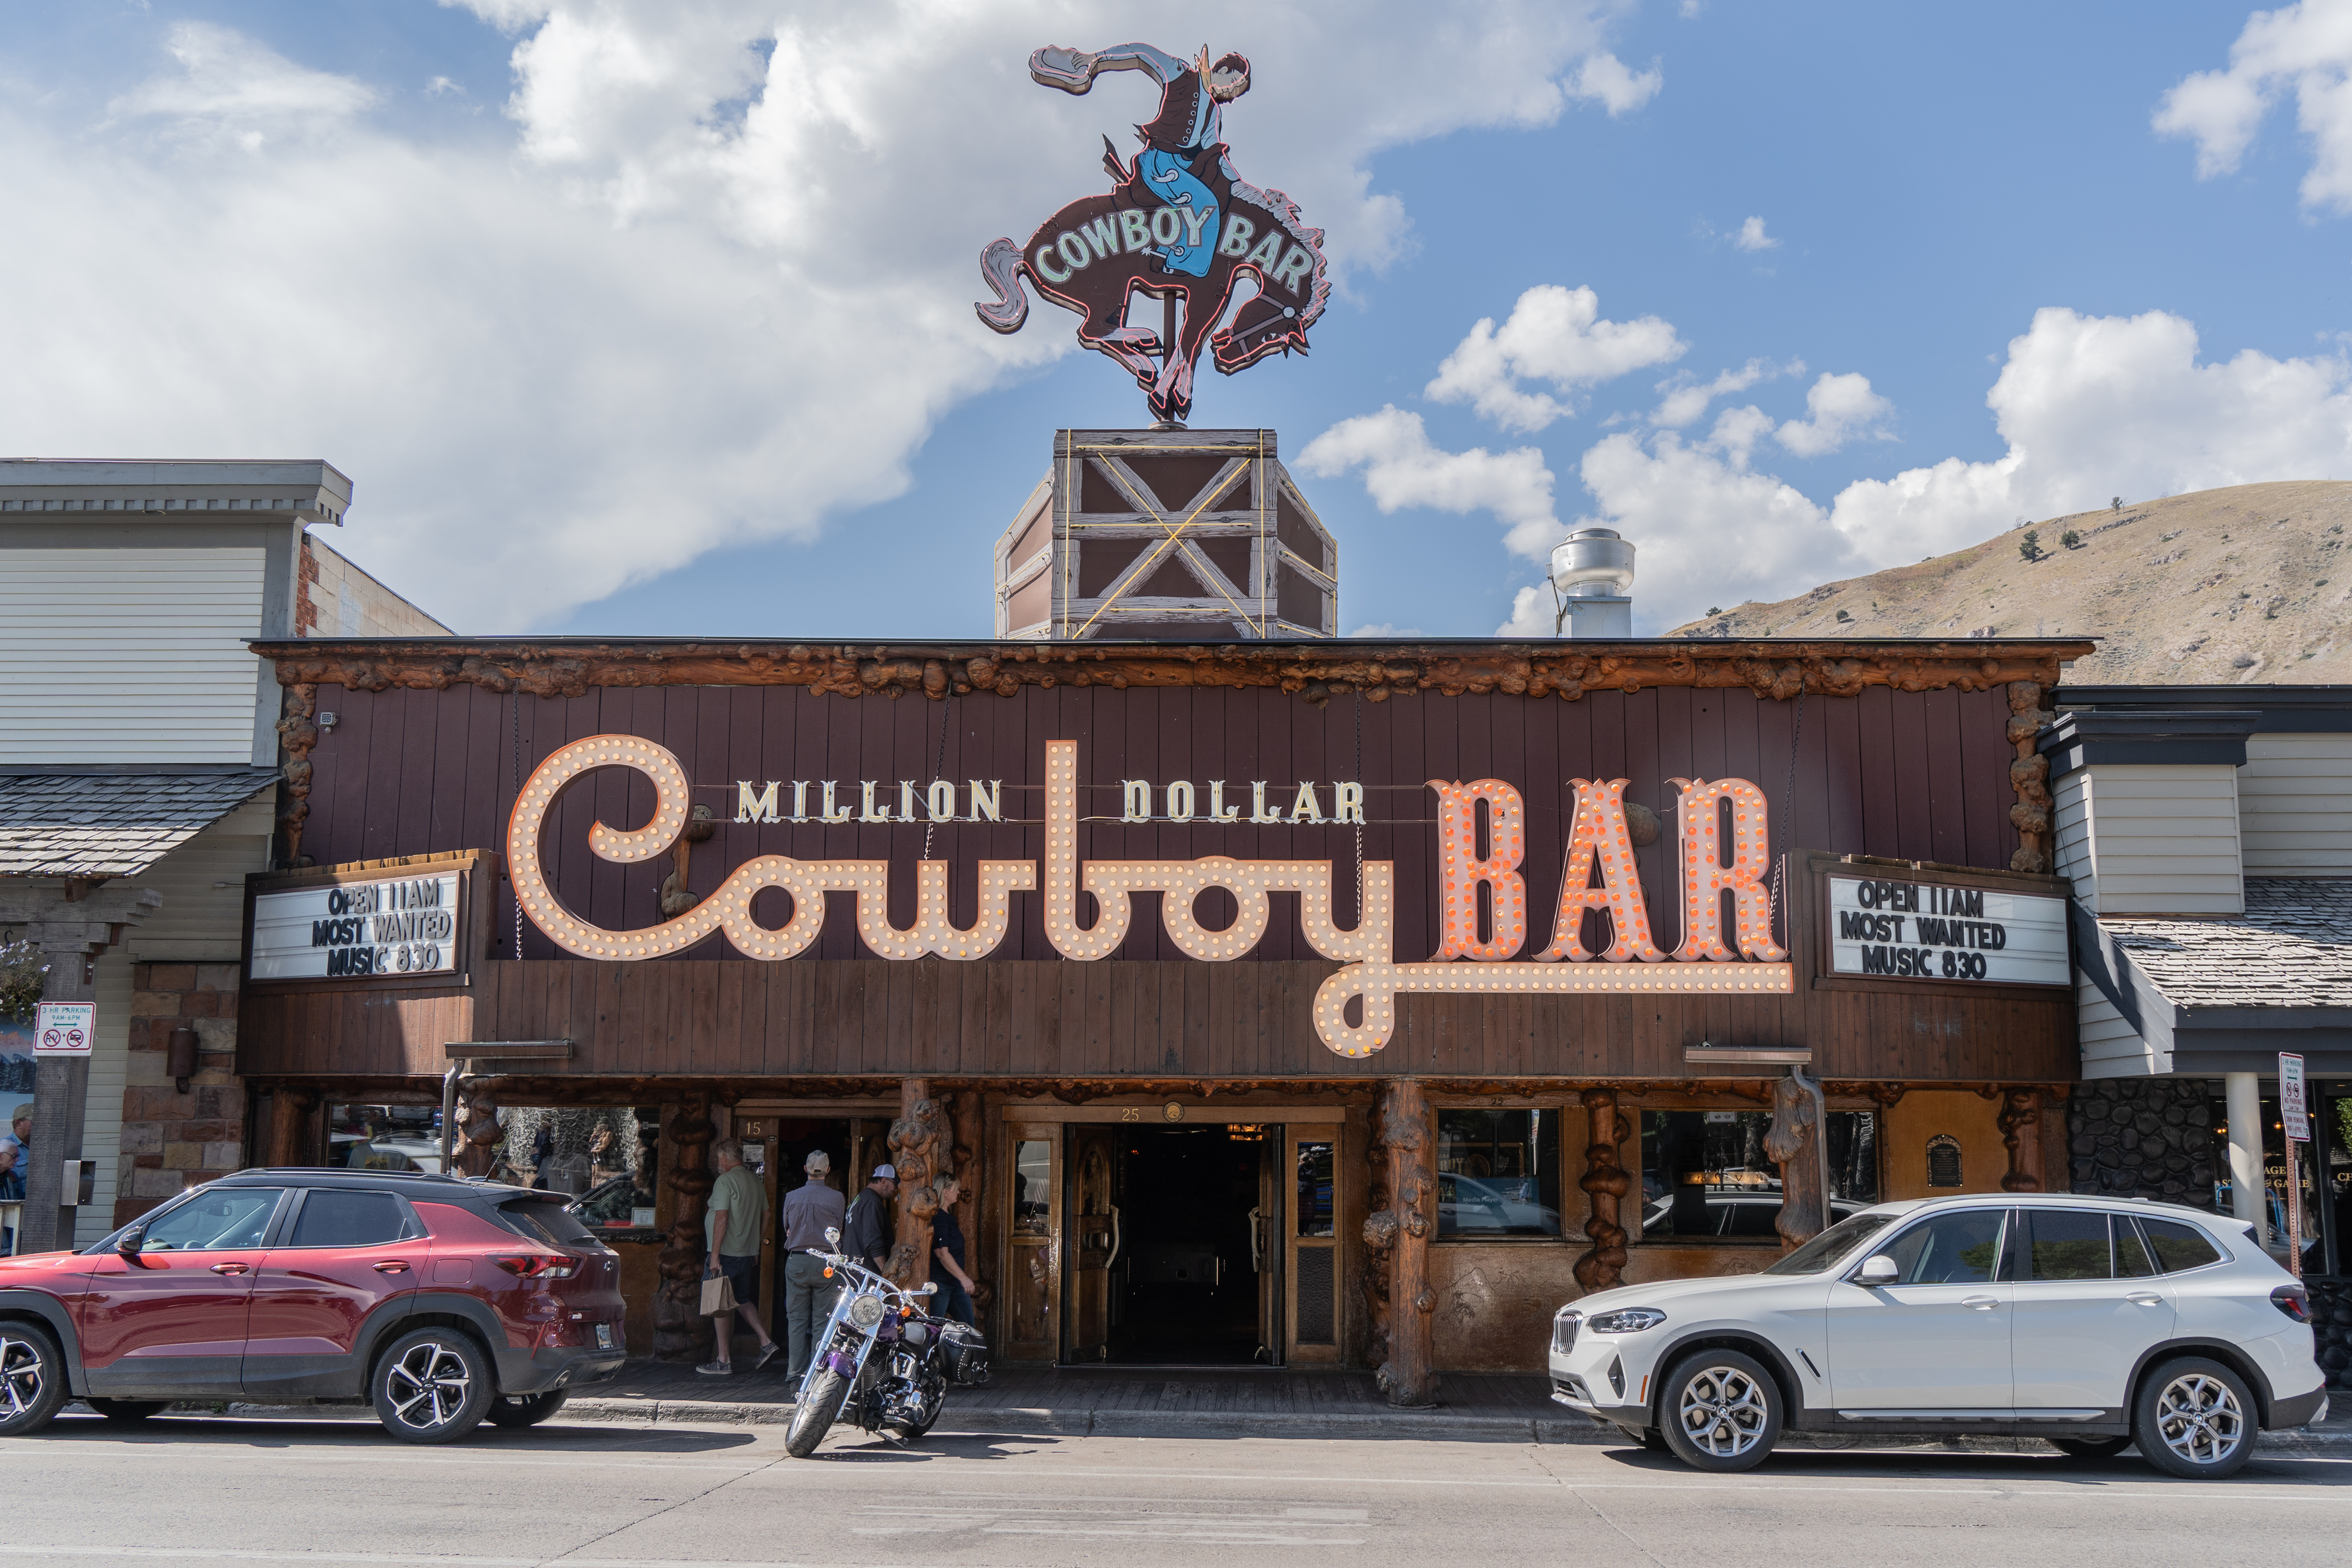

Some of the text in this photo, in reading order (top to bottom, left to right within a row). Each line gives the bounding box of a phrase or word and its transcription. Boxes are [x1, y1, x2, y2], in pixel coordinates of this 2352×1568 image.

[1035, 206, 1315, 297] COWBOY BAR
[734, 780, 1366, 824] MILLION DOLLAR
[328, 884, 378, 915] OPEN
[507, 734, 1790, 1058] Cowboy BAR
[1858, 881, 1919, 912] OPEN
[312, 910, 451, 947] MOST WANTED
[1840, 911, 2006, 951] MOST WANTED
[327, 942, 439, 976] MUSIC 830
[1862, 945, 1987, 979] MUSIC 830
[2290, 1059, 2301, 1067] PARKING
[746, 1121, 760, 1135] 15
[1122, 1108, 1139, 1121] 25
[2274, 1179, 2309, 1188] GAE
